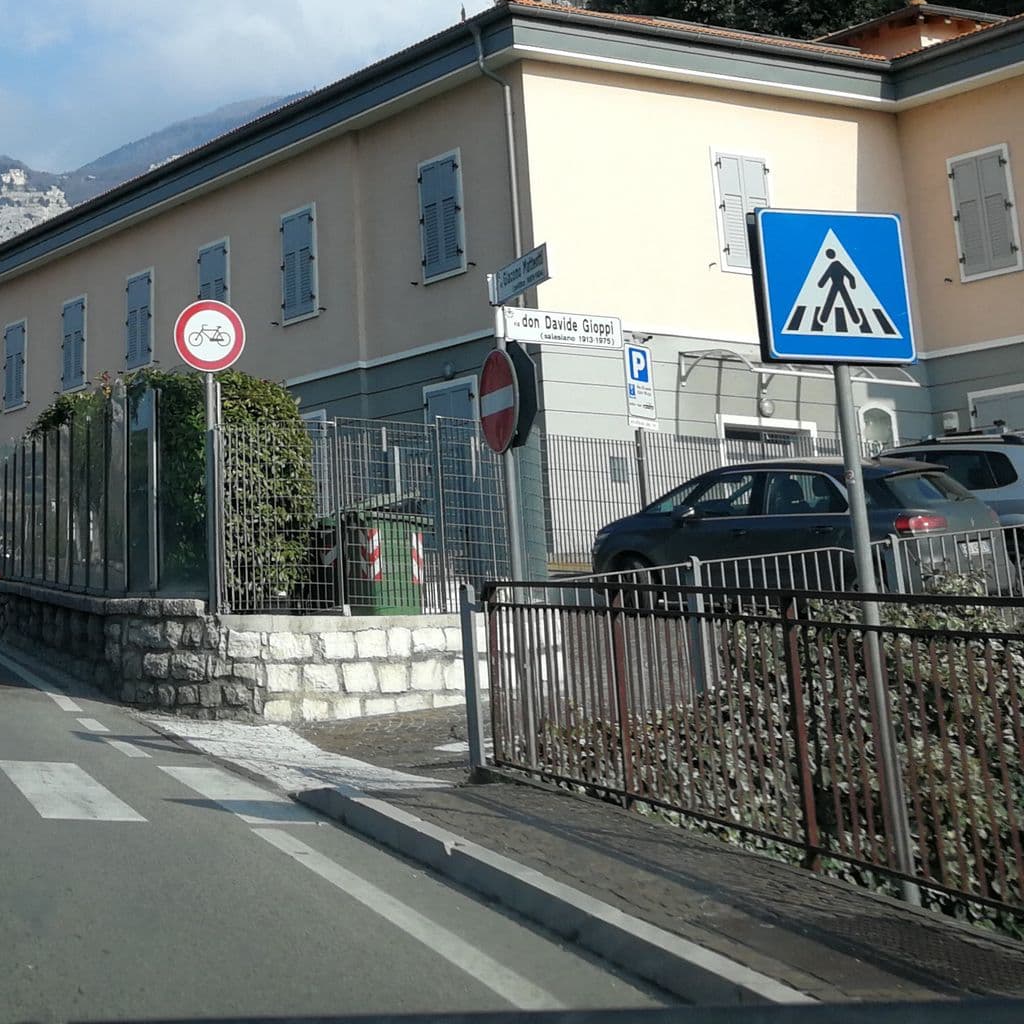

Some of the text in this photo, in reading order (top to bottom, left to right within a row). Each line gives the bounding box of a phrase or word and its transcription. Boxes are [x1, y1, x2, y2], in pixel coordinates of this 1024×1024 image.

[522, 314, 539, 328] don
[545, 316, 578, 332] Davide
[582, 318, 614, 336] Gioppi
[632, 350, 645, 379] P
